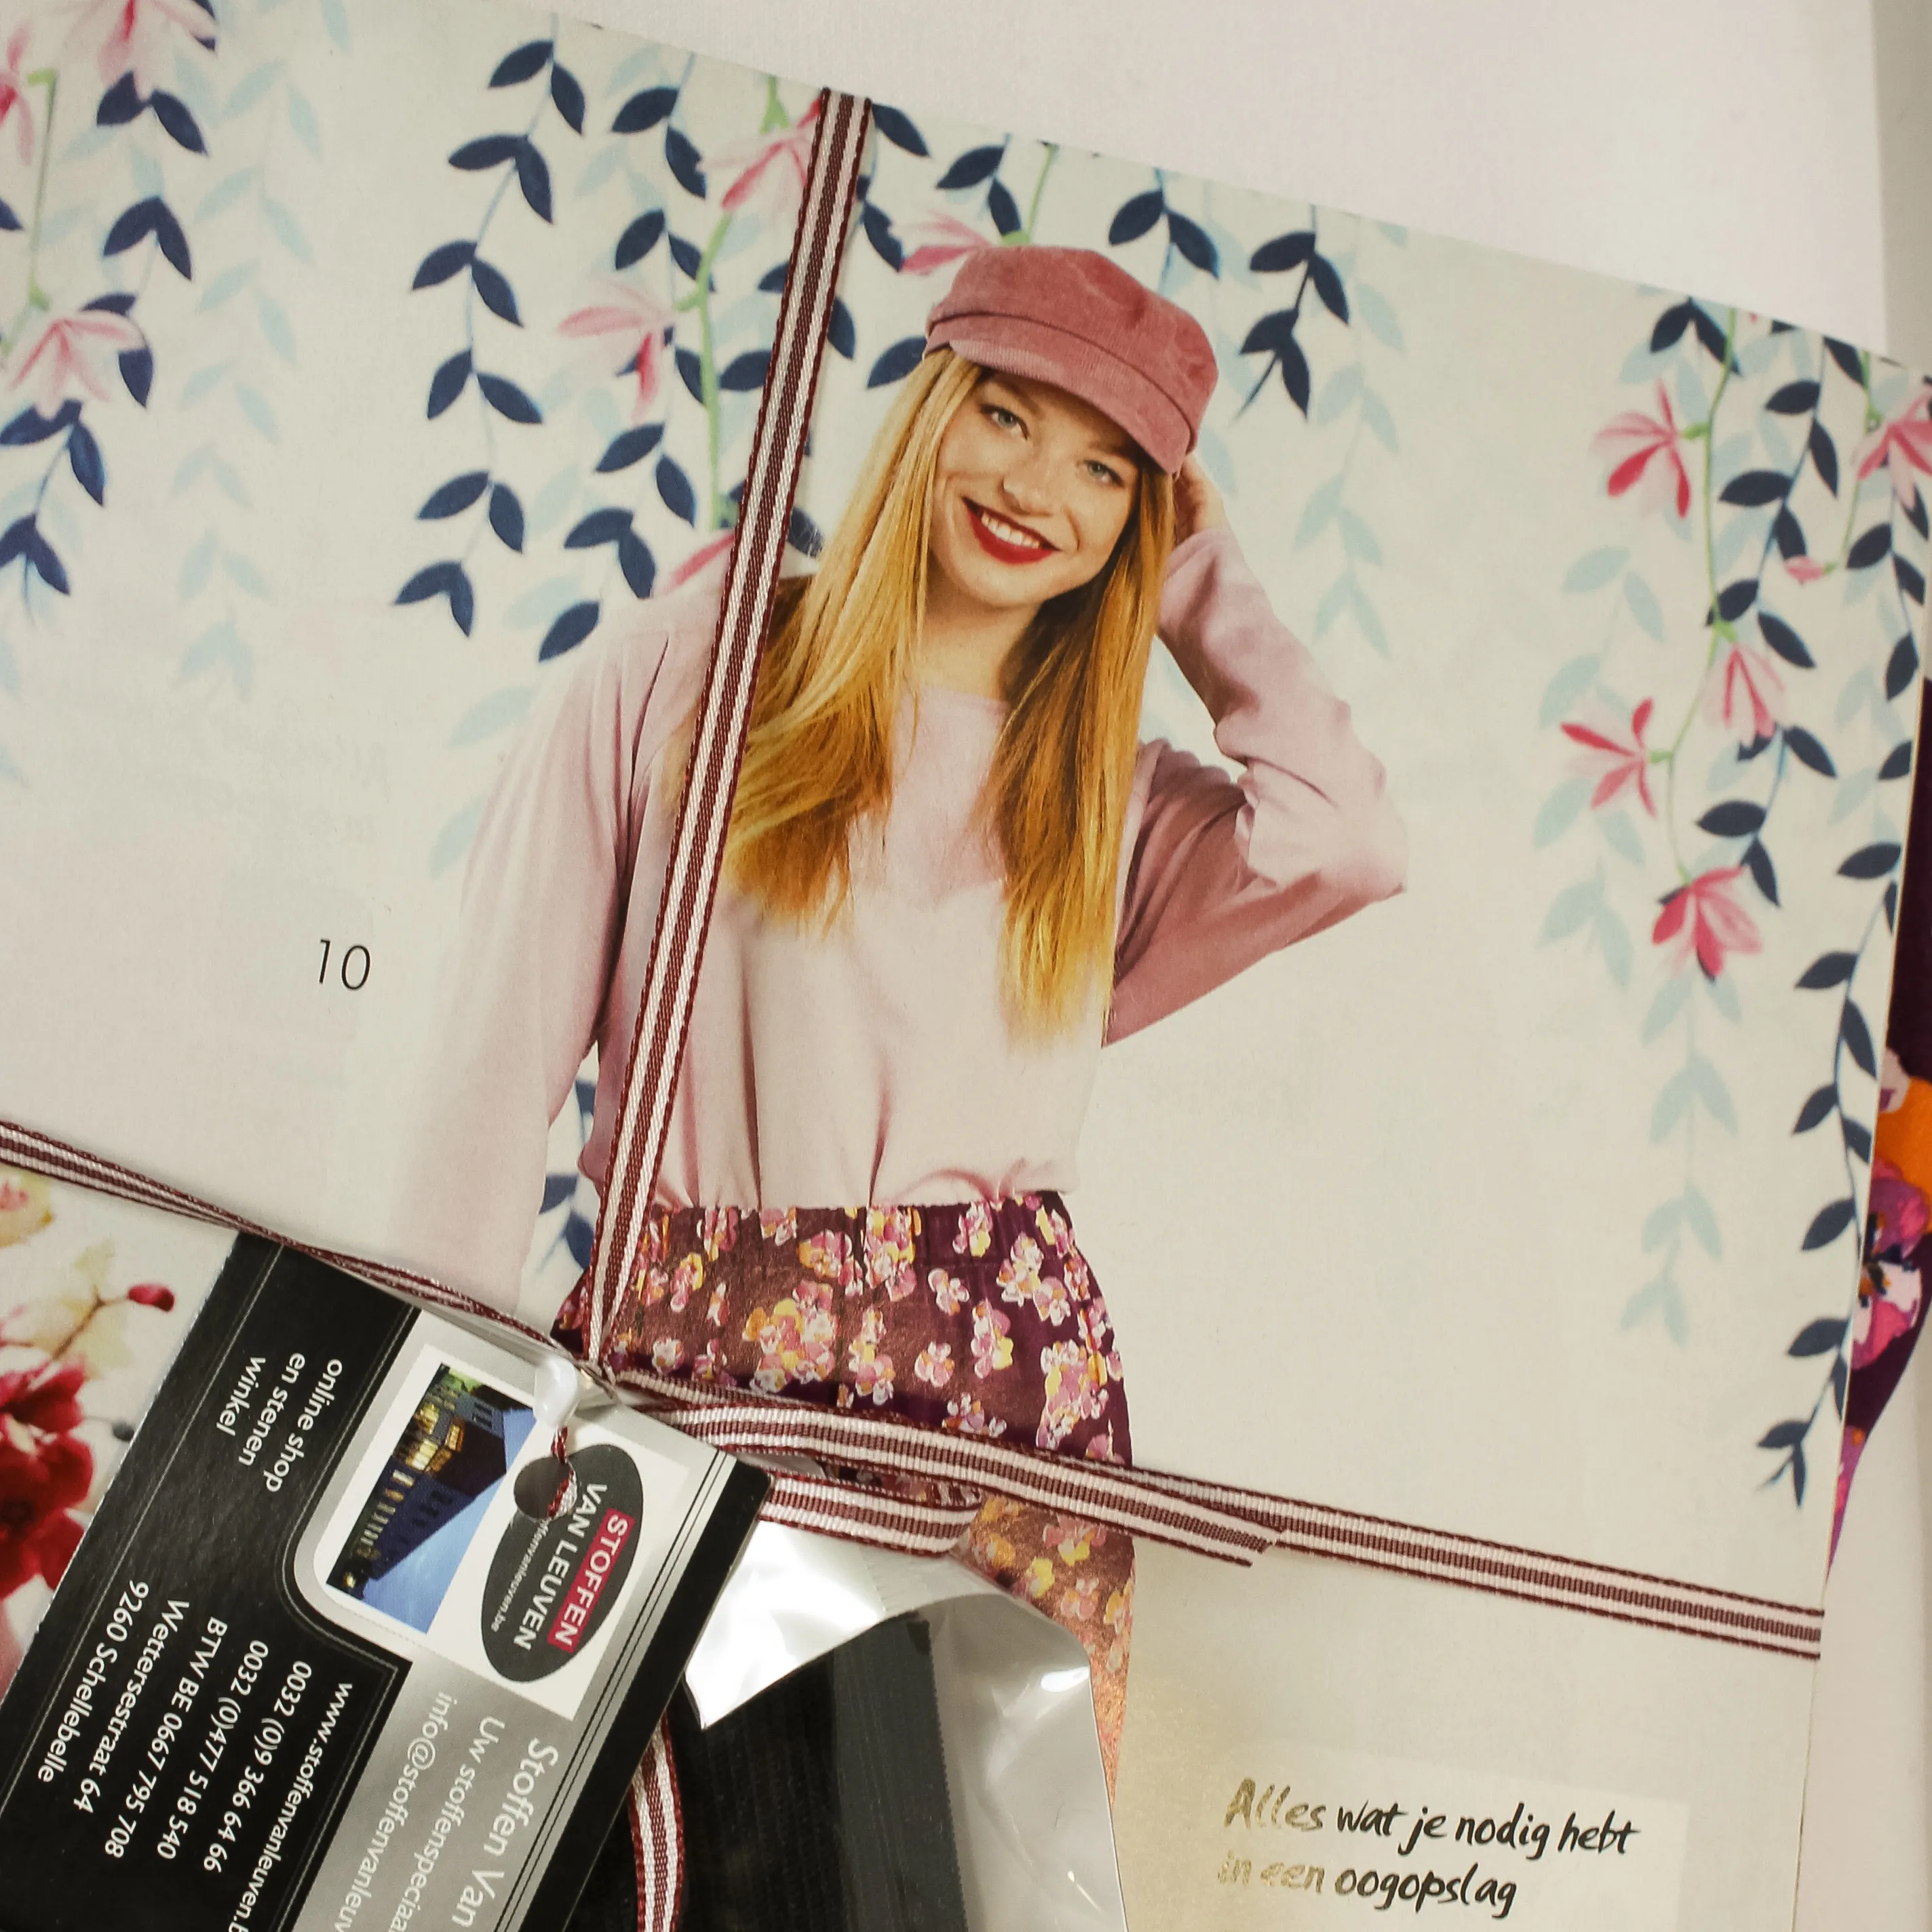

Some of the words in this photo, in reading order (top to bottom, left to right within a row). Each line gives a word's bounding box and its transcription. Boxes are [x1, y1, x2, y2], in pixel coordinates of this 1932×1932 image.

[320, 938, 371, 990] 10
[216, 1357, 267, 1437] winkel
[281, 1353, 305, 1384] en
[297, 1359, 343, 1431] online
[238, 1386, 288, 1466] stenen
[263, 1432, 305, 1492] shop
[566, 1483, 608, 1539] VAN
[513, 1539, 579, 1651] LEUVEN
[554, 1514, 629, 1646] STOFFEN
[107, 1580, 149, 1643] 9260
[189, 1617, 228, 1679] BTW
[230, 1640, 269, 1696] 0032
[38, 1642, 118, 1783] Schellebelle
[89, 1600, 190, 1776] Wettersestraat
[171, 1676, 199, 1712] BE
[273, 1660, 312, 1717] 0032
[147, 1712, 182, 1771] 0667
[199, 1697, 242, 1773] (0)477
[253, 1717, 285, 1766] (0)9
[469, 1716, 505, 1764] Uw
[73, 1777, 101, 1813] 64
[125, 1769, 157, 1814] 795
[176, 1769, 209, 1815] 518
[232, 1765, 265, 1809] 366
[483, 1737, 559, 1857] Stoffen
[104, 1814, 136, 1859] 708
[156, 1814, 189, 1860] 540
[217, 1811, 242, 1842] 64
[1223, 1777, 1326, 1831] Alles
[1336, 1799, 1408, 1836] wat
[1397, 1806, 1447, 1856] je
[1454, 1802, 1551, 1860] nodig
[1557, 1809, 1640, 1855] hebt
[203, 1842, 228, 1873] 66
[1217, 1849, 1252, 1887] in
[1259, 1863, 1325, 1895] een
[1334, 1862, 1517, 1918] oogopslag
[451, 1870, 505, 1927] Van
